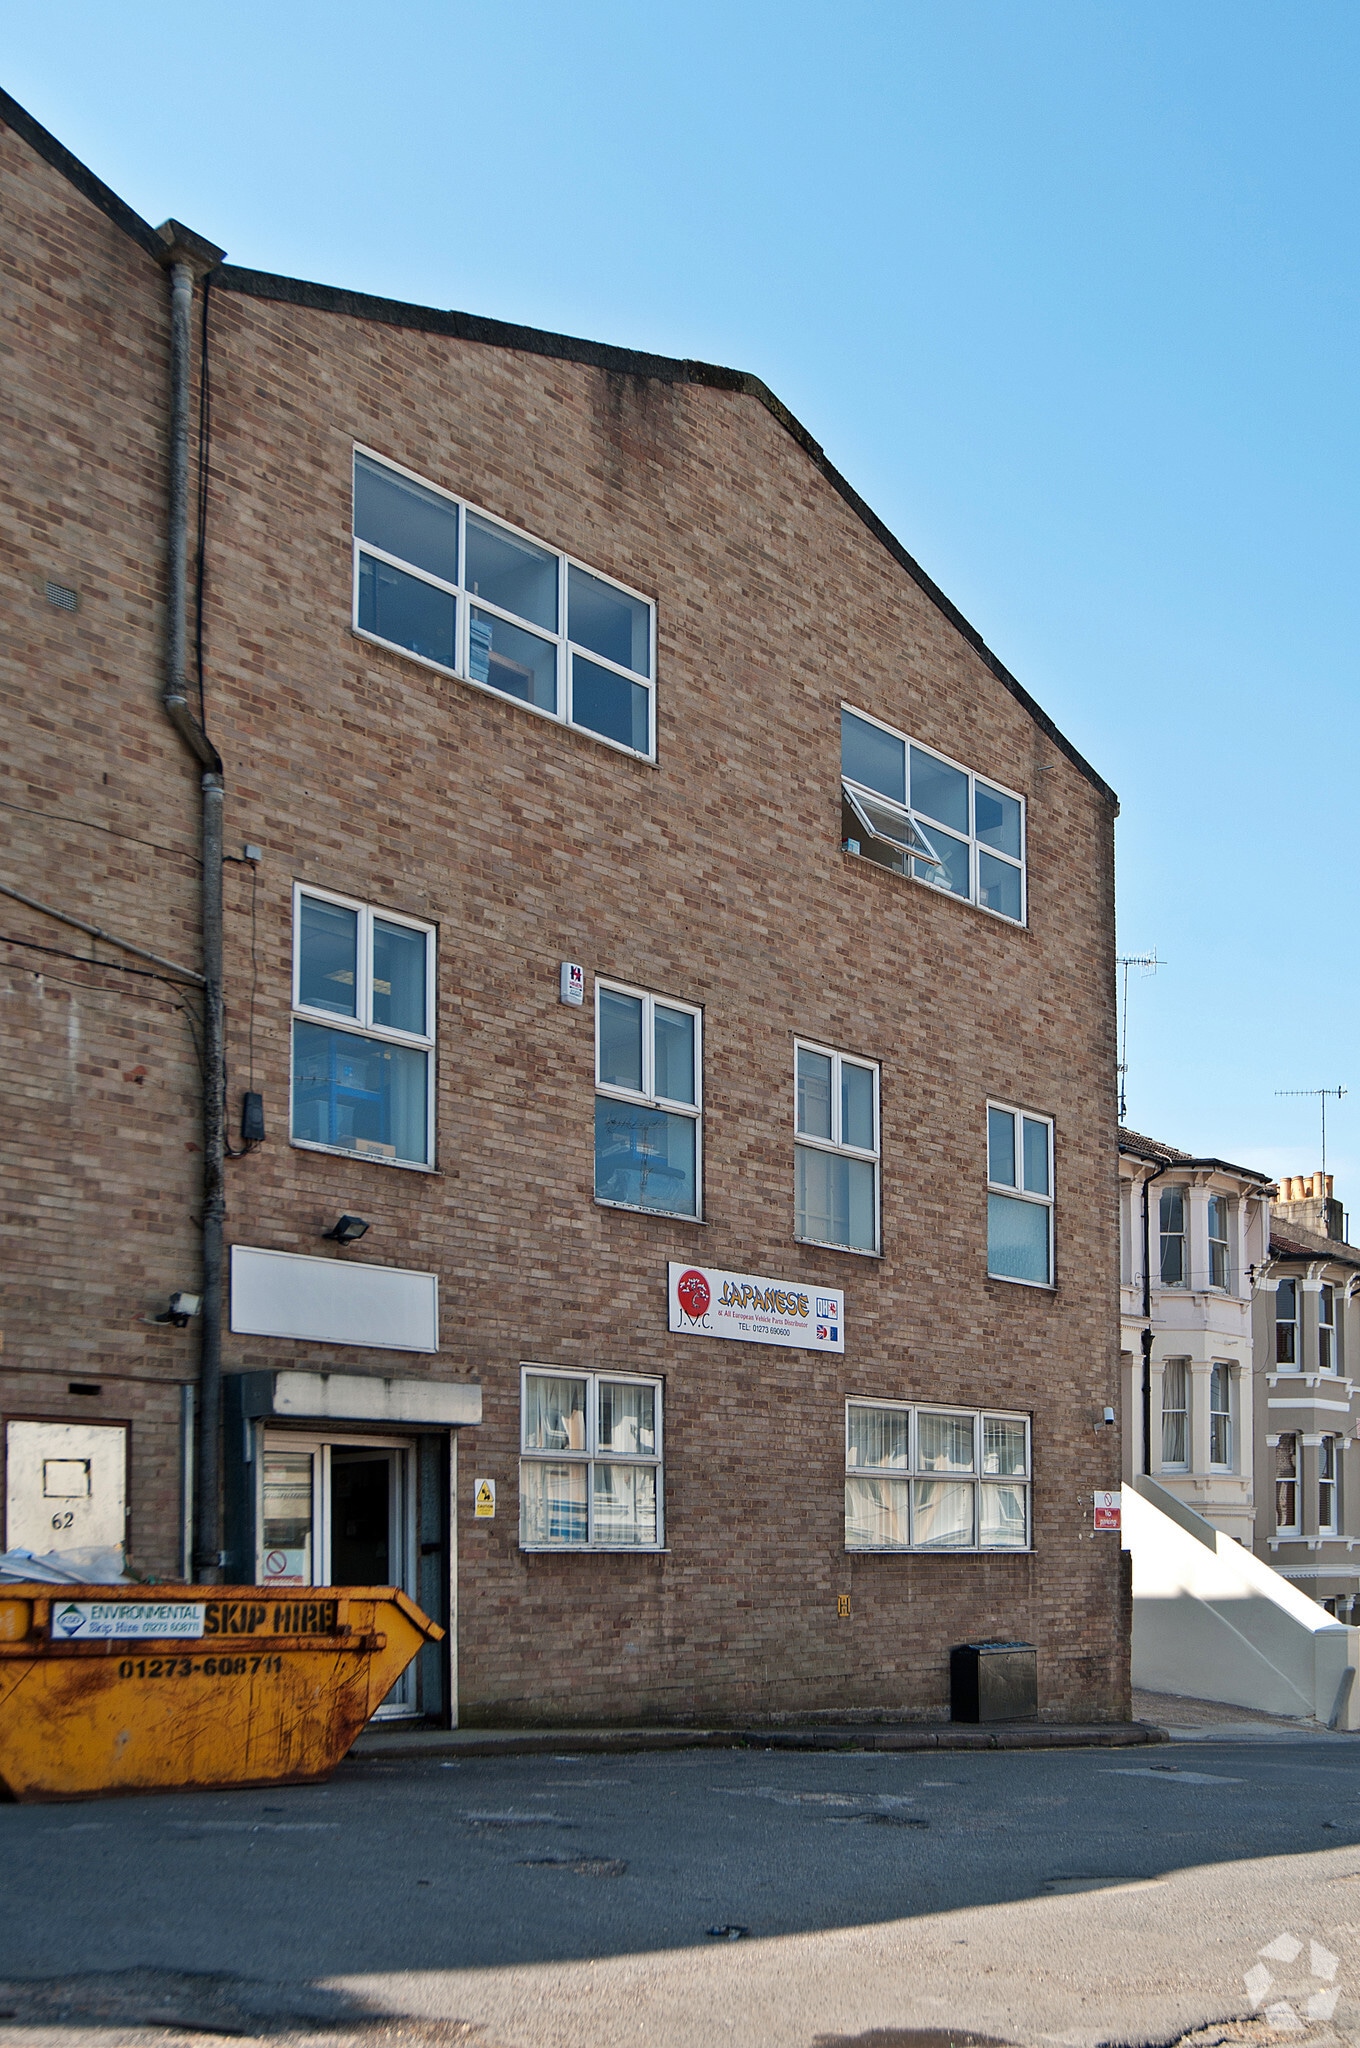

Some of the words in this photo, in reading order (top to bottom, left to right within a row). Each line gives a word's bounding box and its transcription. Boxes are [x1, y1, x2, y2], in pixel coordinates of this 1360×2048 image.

[718, 1280, 809, 1318] JAPANESE
[677, 1308, 714, 1330] J.V.C.
[732, 1311, 754, 1321] European
[755, 1314, 771, 1324] Vehicle
[772, 1317, 783, 1325] Parts
[784, 1319, 808, 1328] Distributor
[739, 1322, 751, 1331] TEL:
[752, 1324, 769, 1334] 01273
[770, 1327, 790, 1337] 690600
[51, 1511, 74, 1530] 62
[91, 1605, 200, 1620] ENVIRONMENTAL
[204, 1603, 267, 1634] SKIP
[273, 1603, 333, 1634] HIRE
[89, 1621, 113, 1636] Skip
[115, 1621, 139, 1633] Hire
[142, 1622, 167, 1633] 01273
[118, 1656, 282, 1679] 01273-608711
